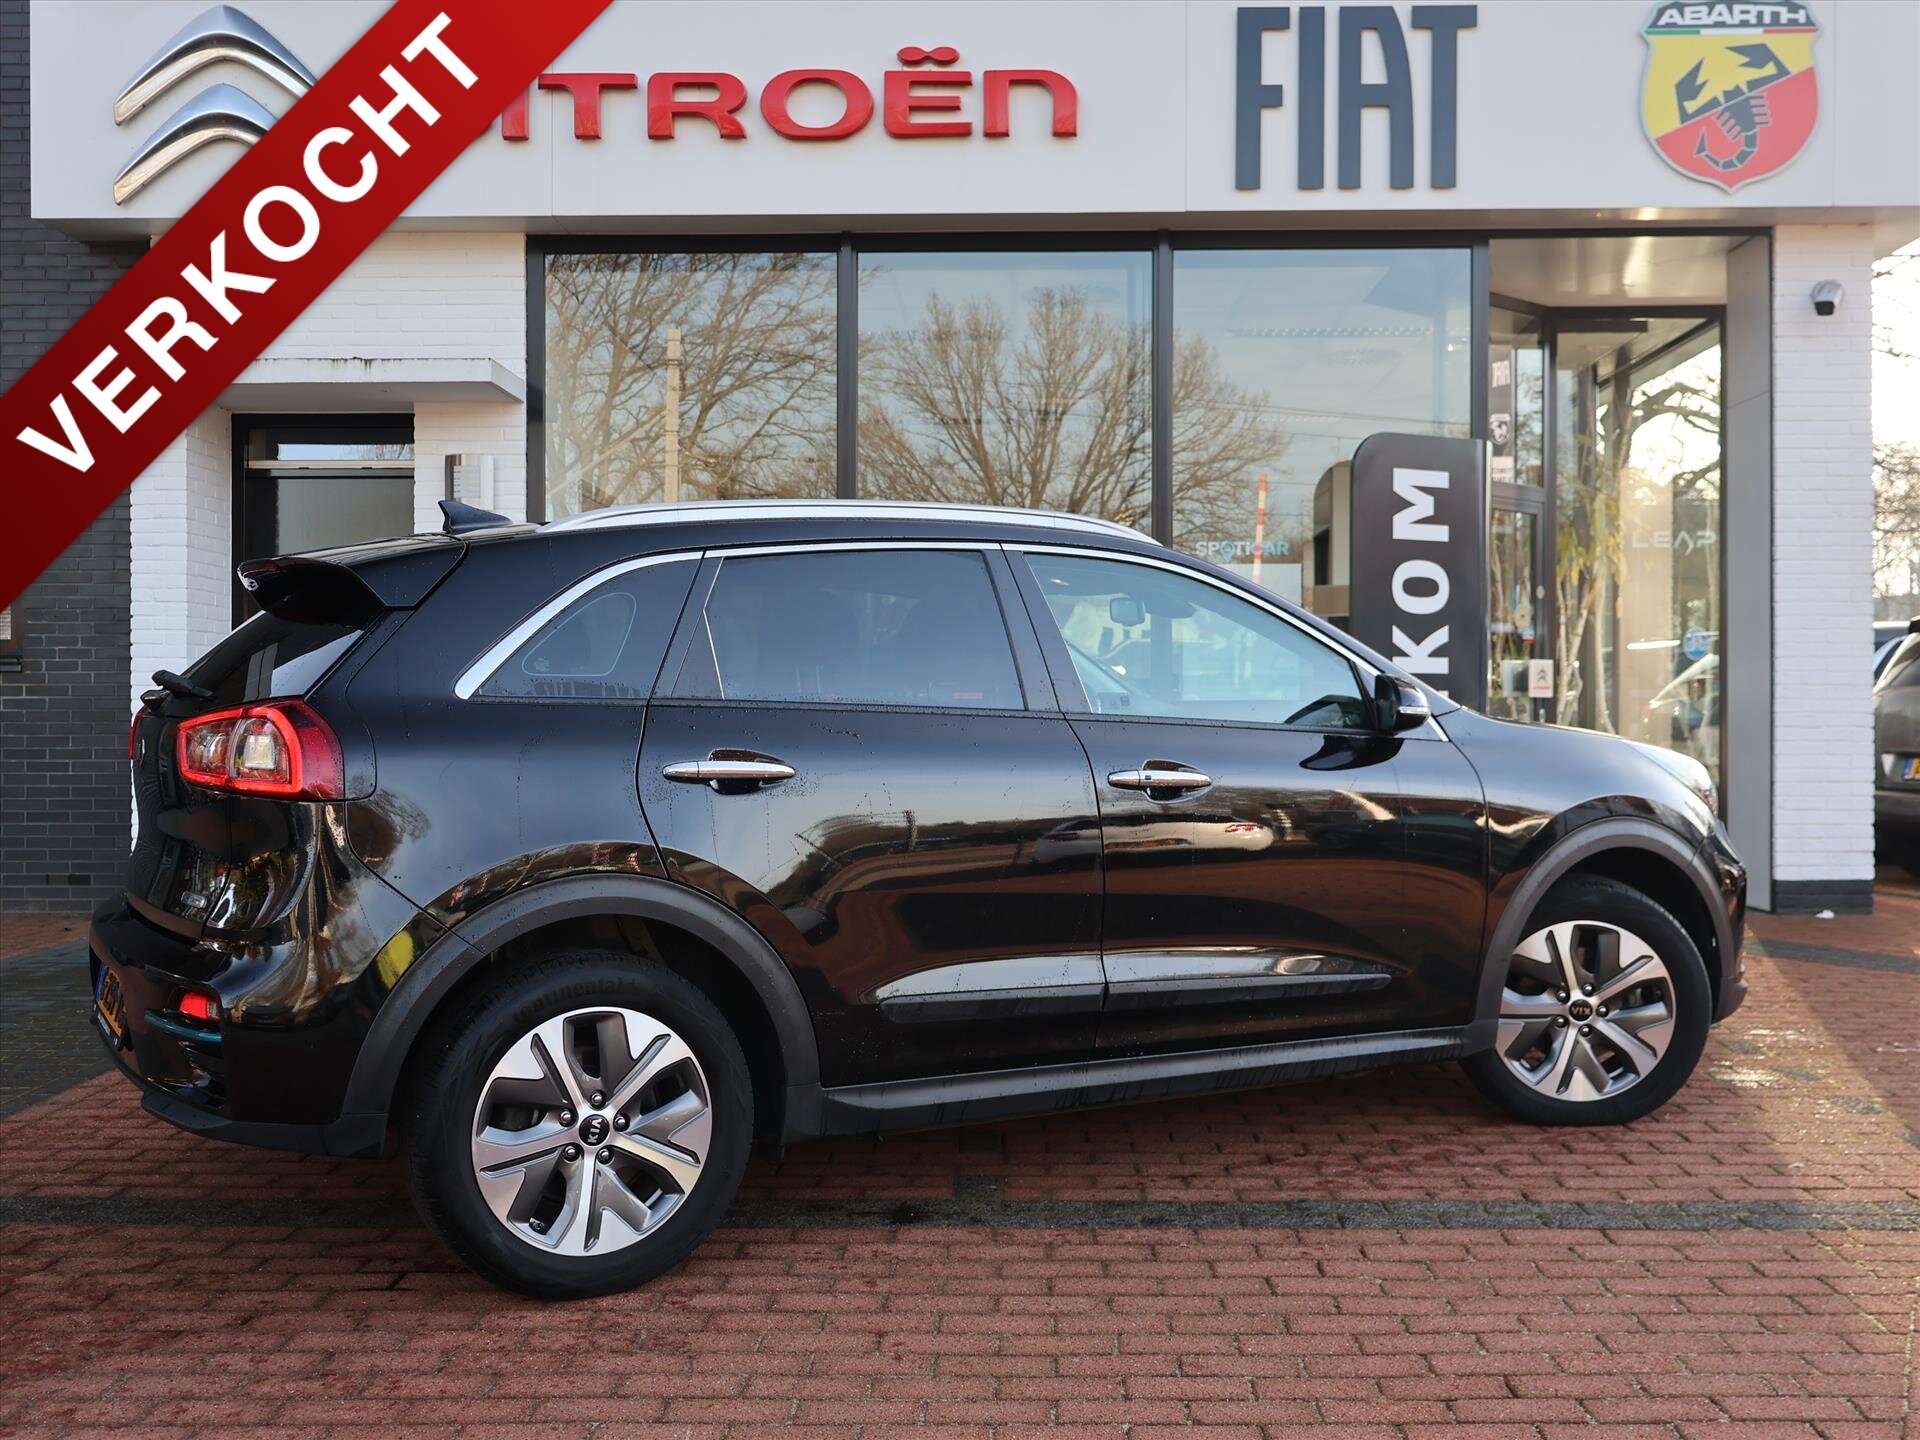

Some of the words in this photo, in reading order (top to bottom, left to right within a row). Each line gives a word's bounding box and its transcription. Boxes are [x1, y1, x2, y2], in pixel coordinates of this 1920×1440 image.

[1656, 3, 1807, 26] ABARTH
[479, 46, 1079, 141] ITROËN
[1235, 5, 1478, 190] FIAT
[1391, 467, 1450, 698] KOM
[587, 1118, 603, 1143] KIA
